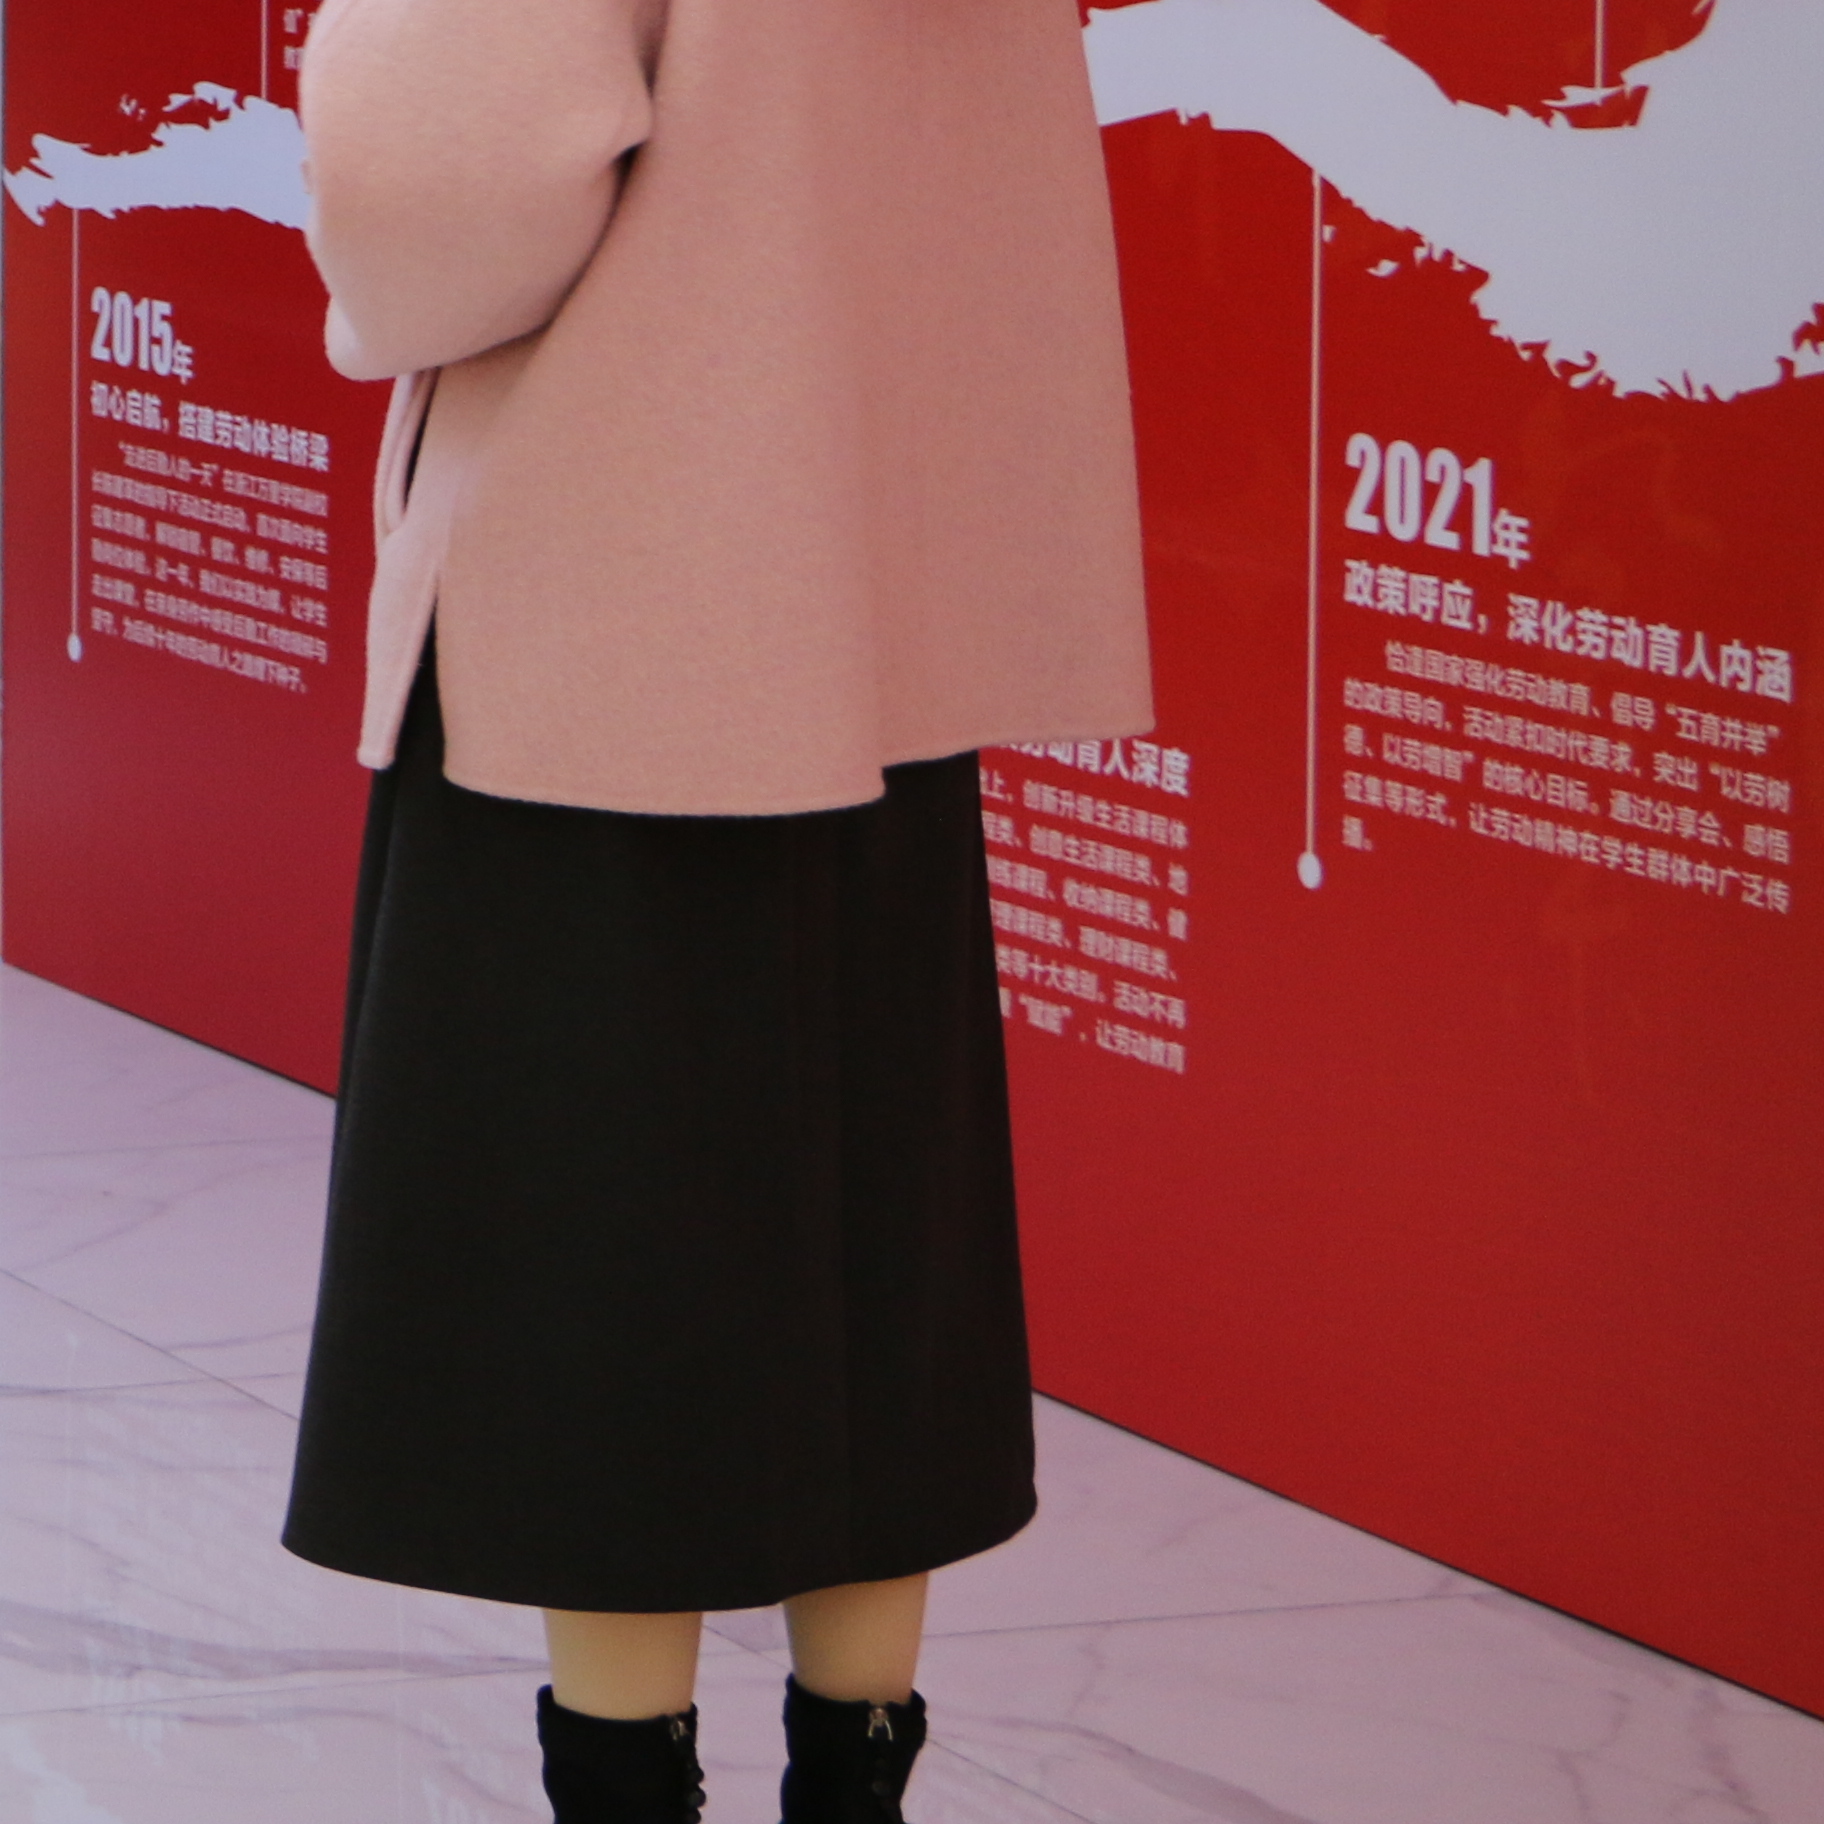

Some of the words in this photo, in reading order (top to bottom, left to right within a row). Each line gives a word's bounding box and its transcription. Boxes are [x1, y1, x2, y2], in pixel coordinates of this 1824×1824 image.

[91, 286, 194, 384] 2015年
[91, 380, 329, 472] 初心启航，搭建劳动体验桥梁
[1344, 432, 1530, 570] 2021年
[1344, 558, 1793, 704] 政策呼应，深化劳动育人内涵
[999, 737, 1190, 798] 动育人深度
